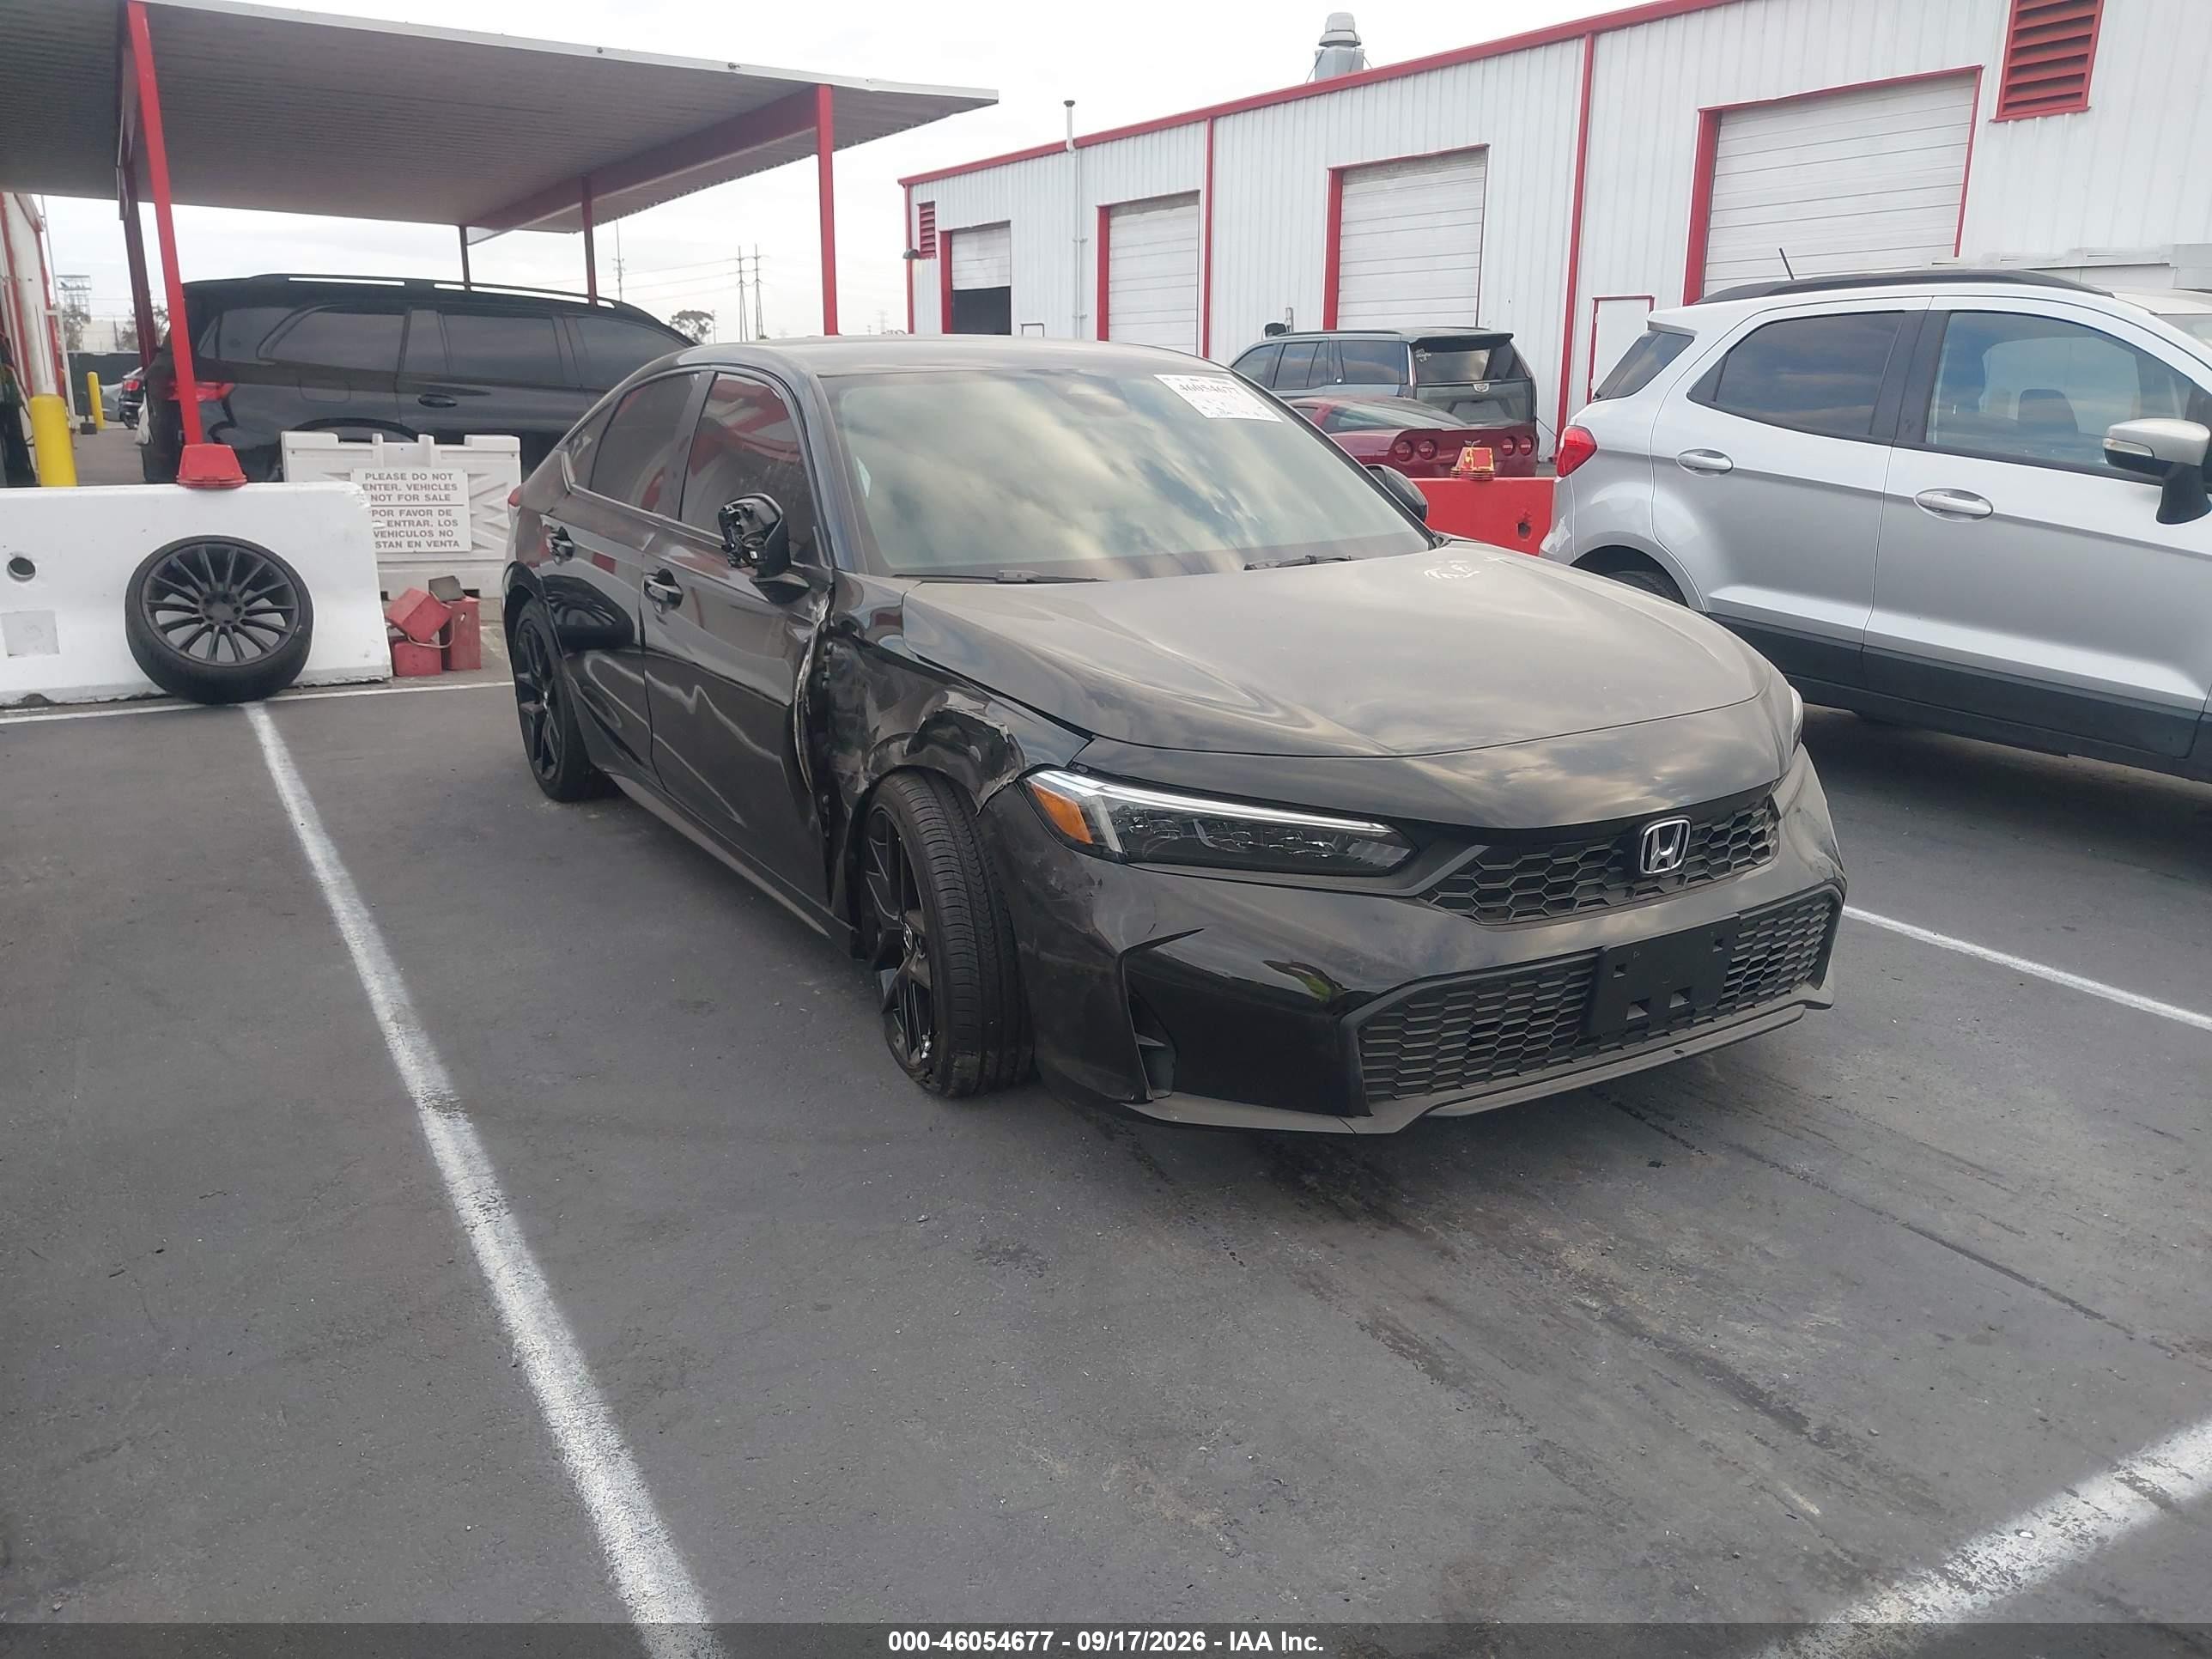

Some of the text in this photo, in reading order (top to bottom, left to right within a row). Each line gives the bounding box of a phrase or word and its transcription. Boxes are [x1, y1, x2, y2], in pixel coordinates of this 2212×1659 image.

[365, 472, 453, 481] PLEASE DO NOT
[370, 494, 451, 502] NOT FOR SALE
[438, 508, 453, 517] DE
[407, 540, 422, 549] EN
